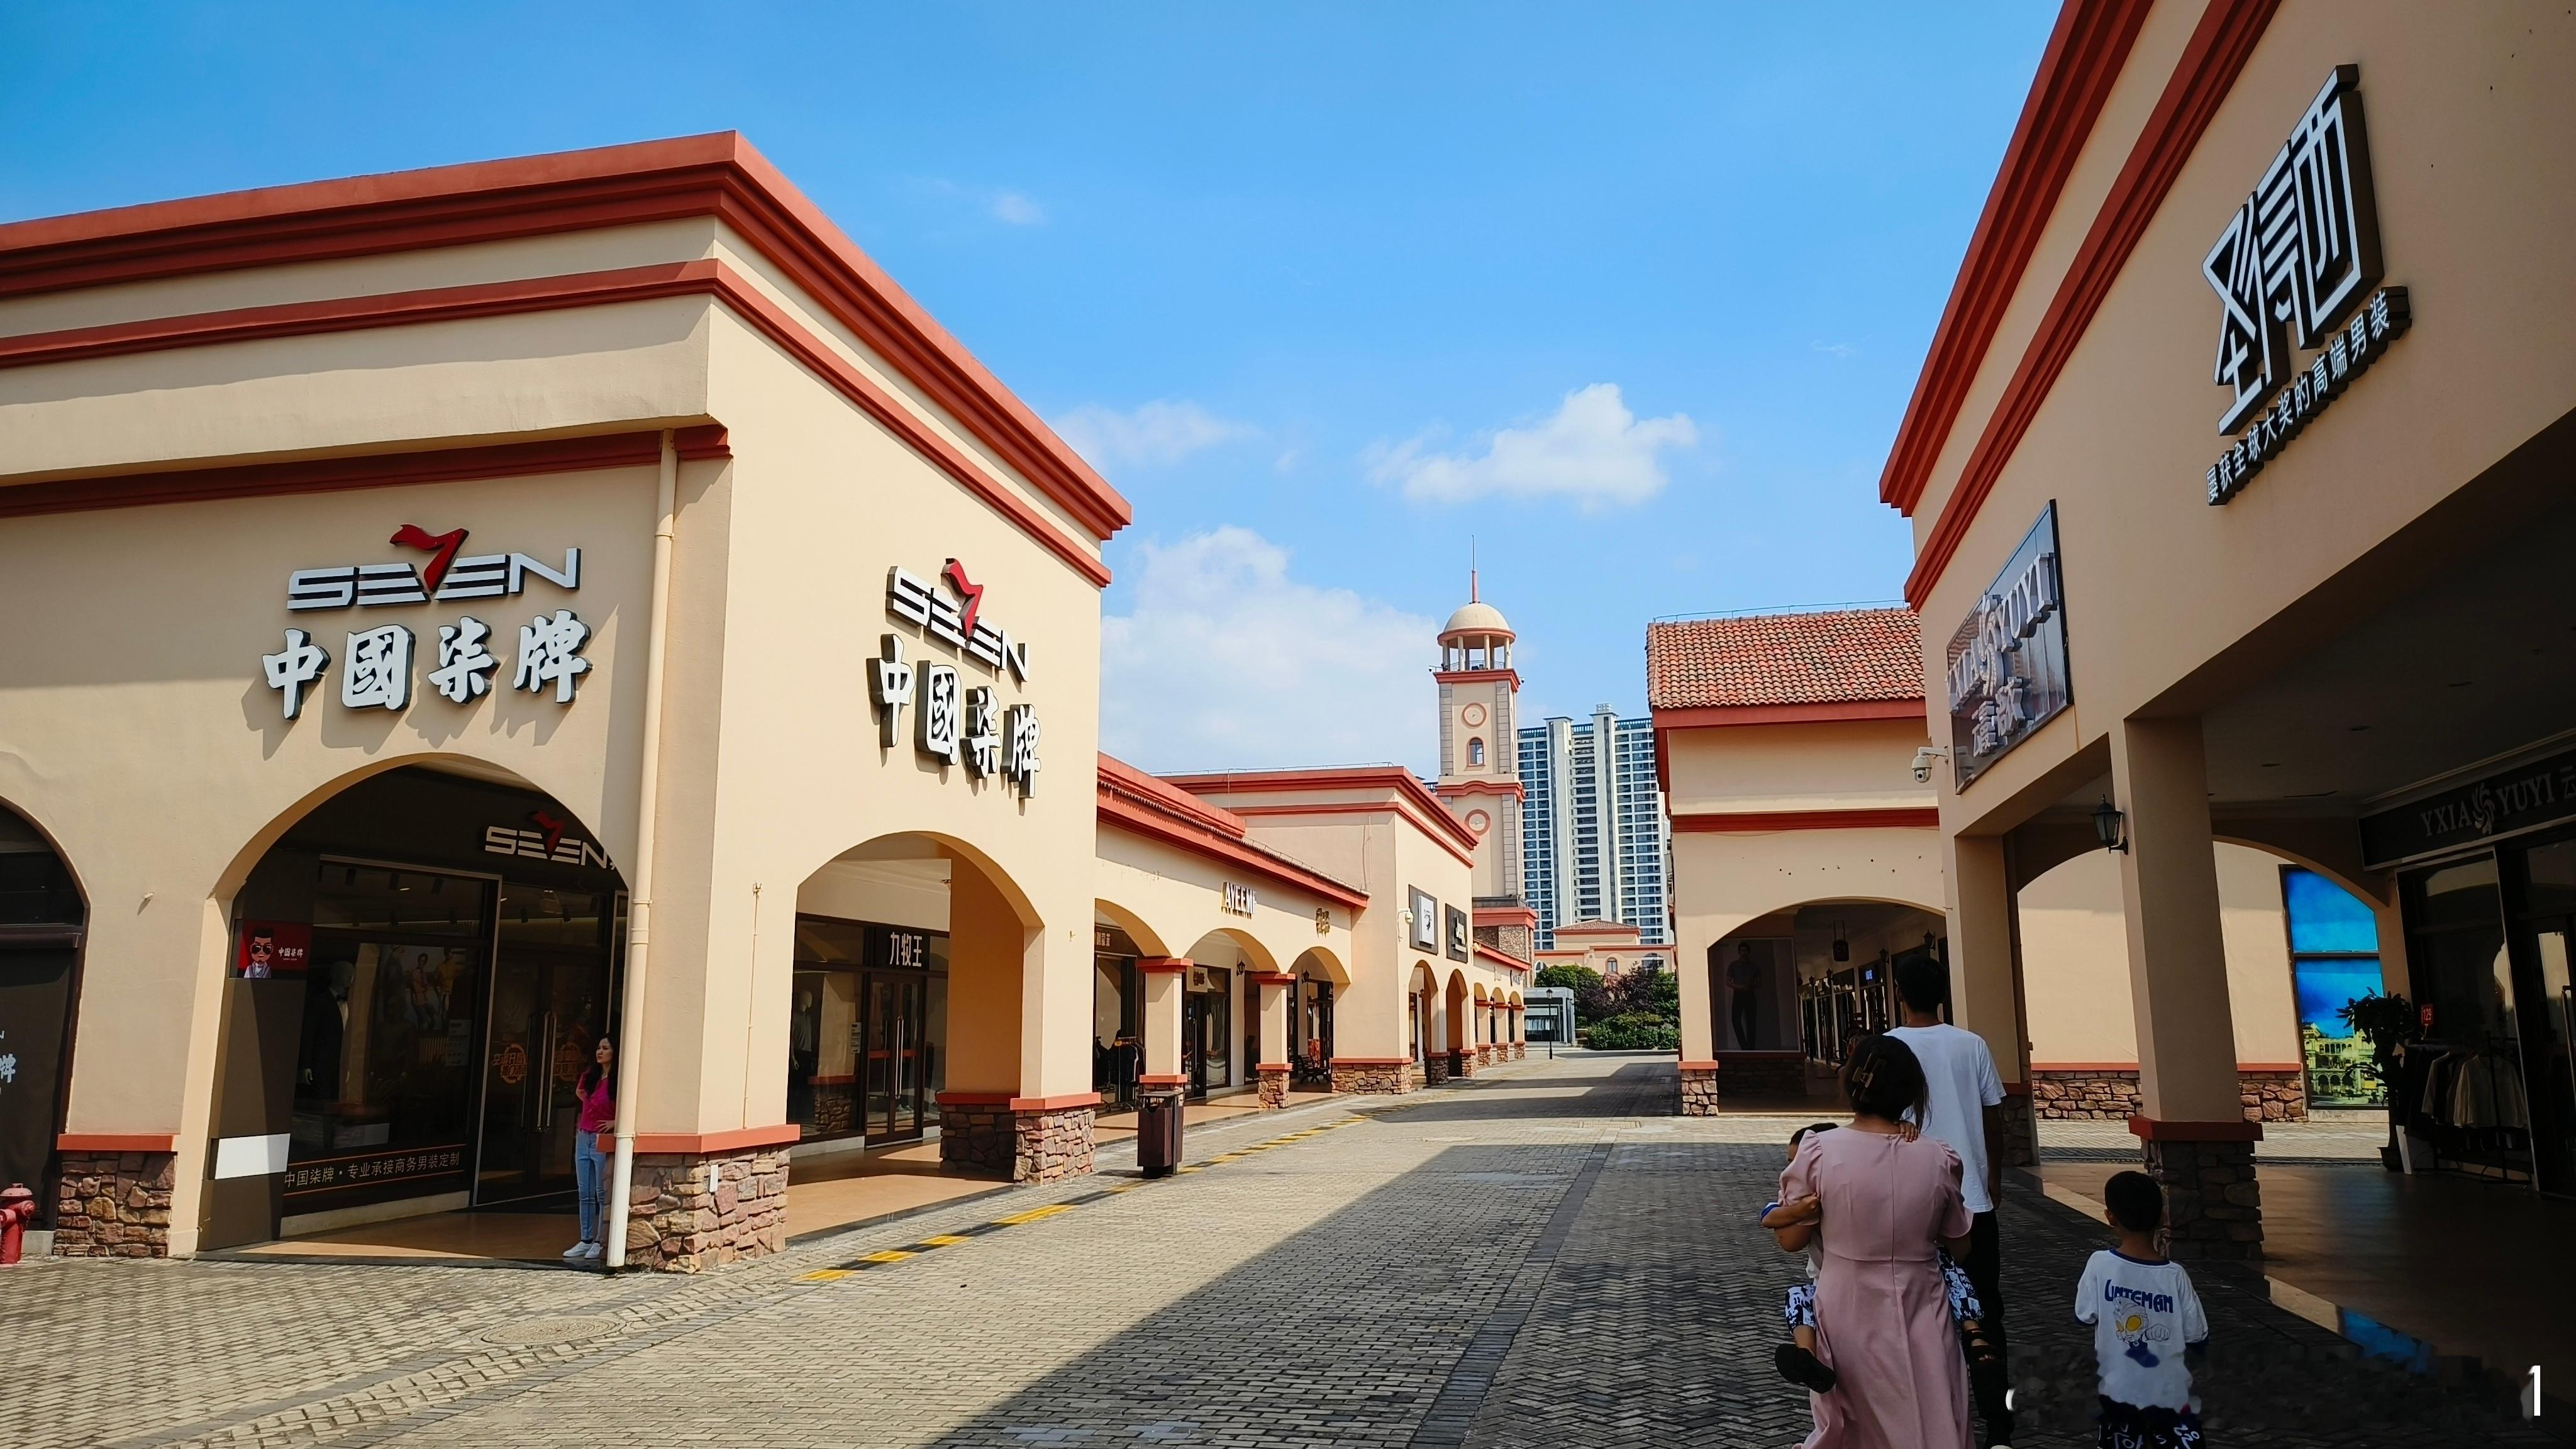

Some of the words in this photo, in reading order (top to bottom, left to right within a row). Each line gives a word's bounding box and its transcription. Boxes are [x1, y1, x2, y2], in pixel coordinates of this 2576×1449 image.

[2207, 289, 2397, 504] 屡获全球大奖的高端男装
